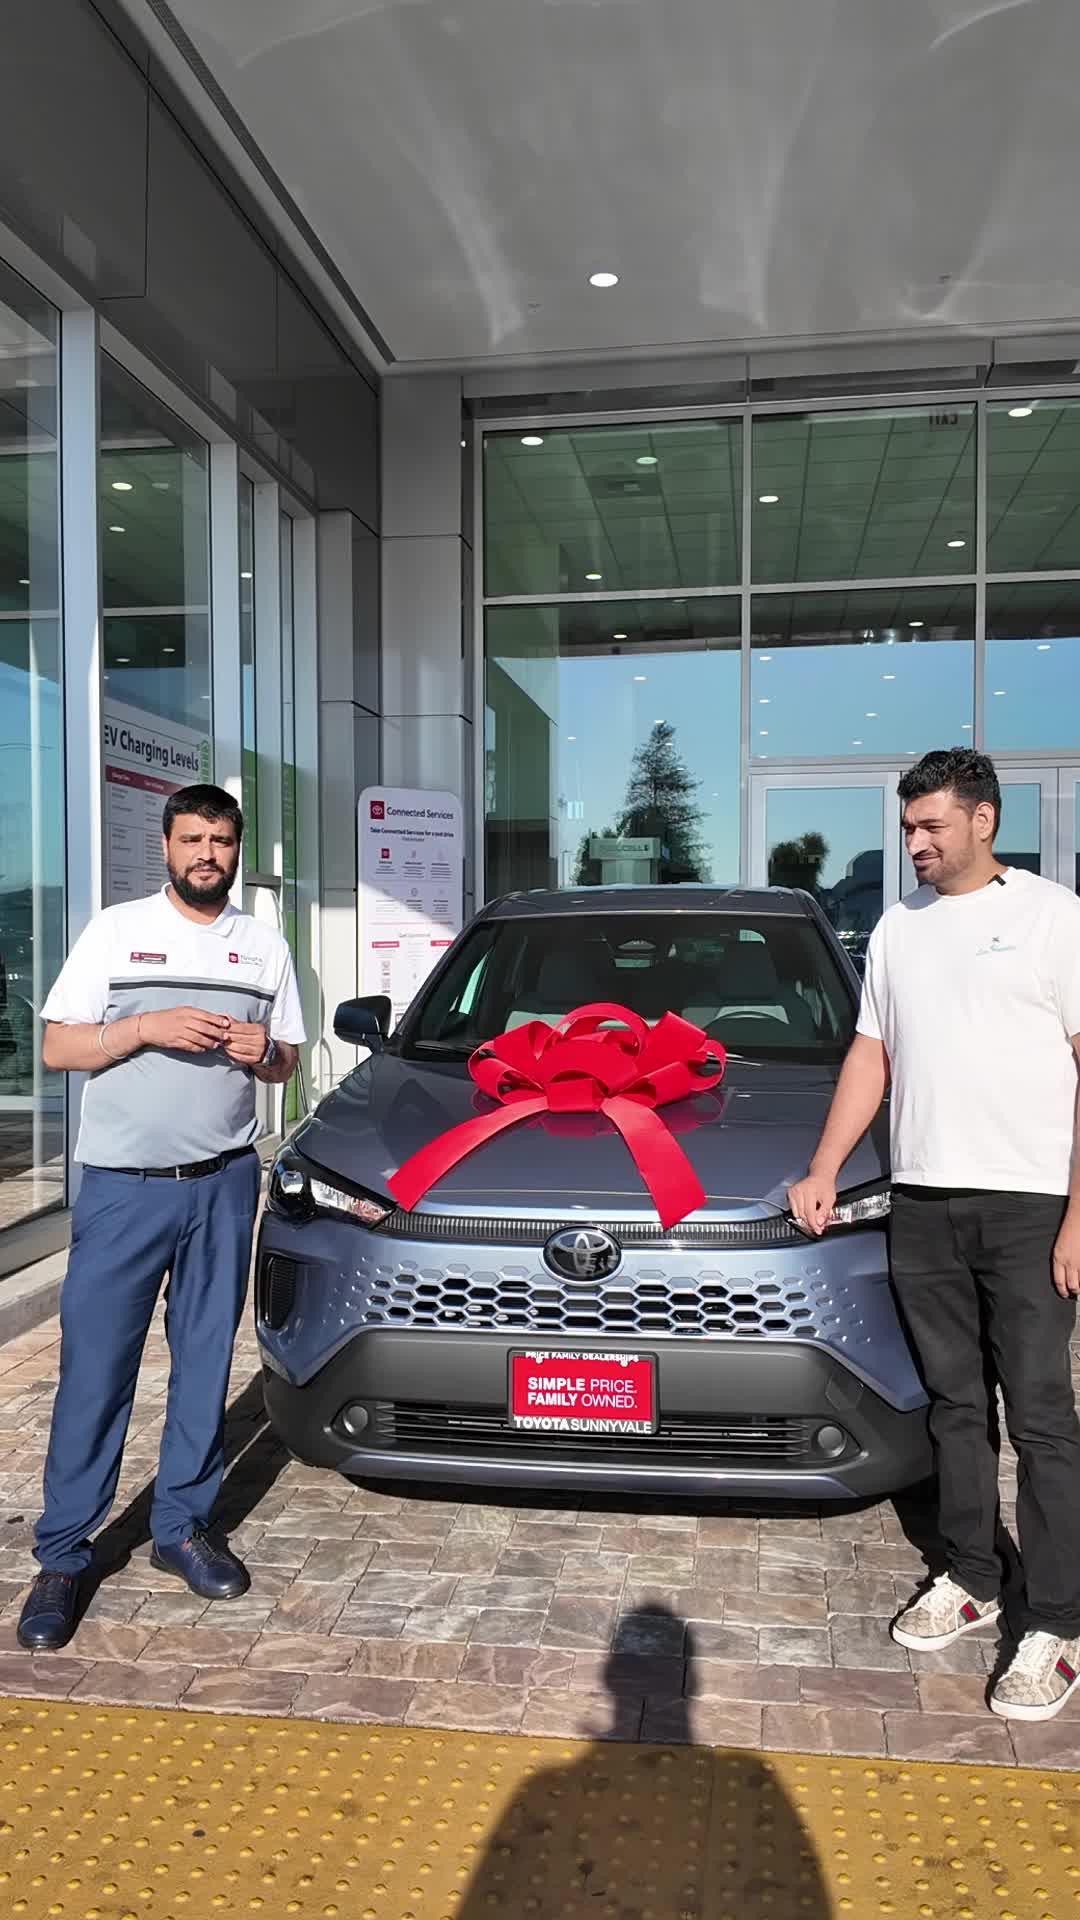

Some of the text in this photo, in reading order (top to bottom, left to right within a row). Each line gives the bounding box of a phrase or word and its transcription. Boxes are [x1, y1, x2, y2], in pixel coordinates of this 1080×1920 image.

[120, 731, 169, 767] Charging
[170, 747, 199, 771] Levels
[386, 806, 454, 820] Connected Services
[525, 1351, 639, 1363] PRICE FAMILY DEALERSHIPS
[527, 1377, 637, 1394] SIMPLE PRICE.
[527, 1392, 638, 1409] FAMILY OWNED.
[513, 1415, 652, 1434] TOYOTA SUNNYVALE
